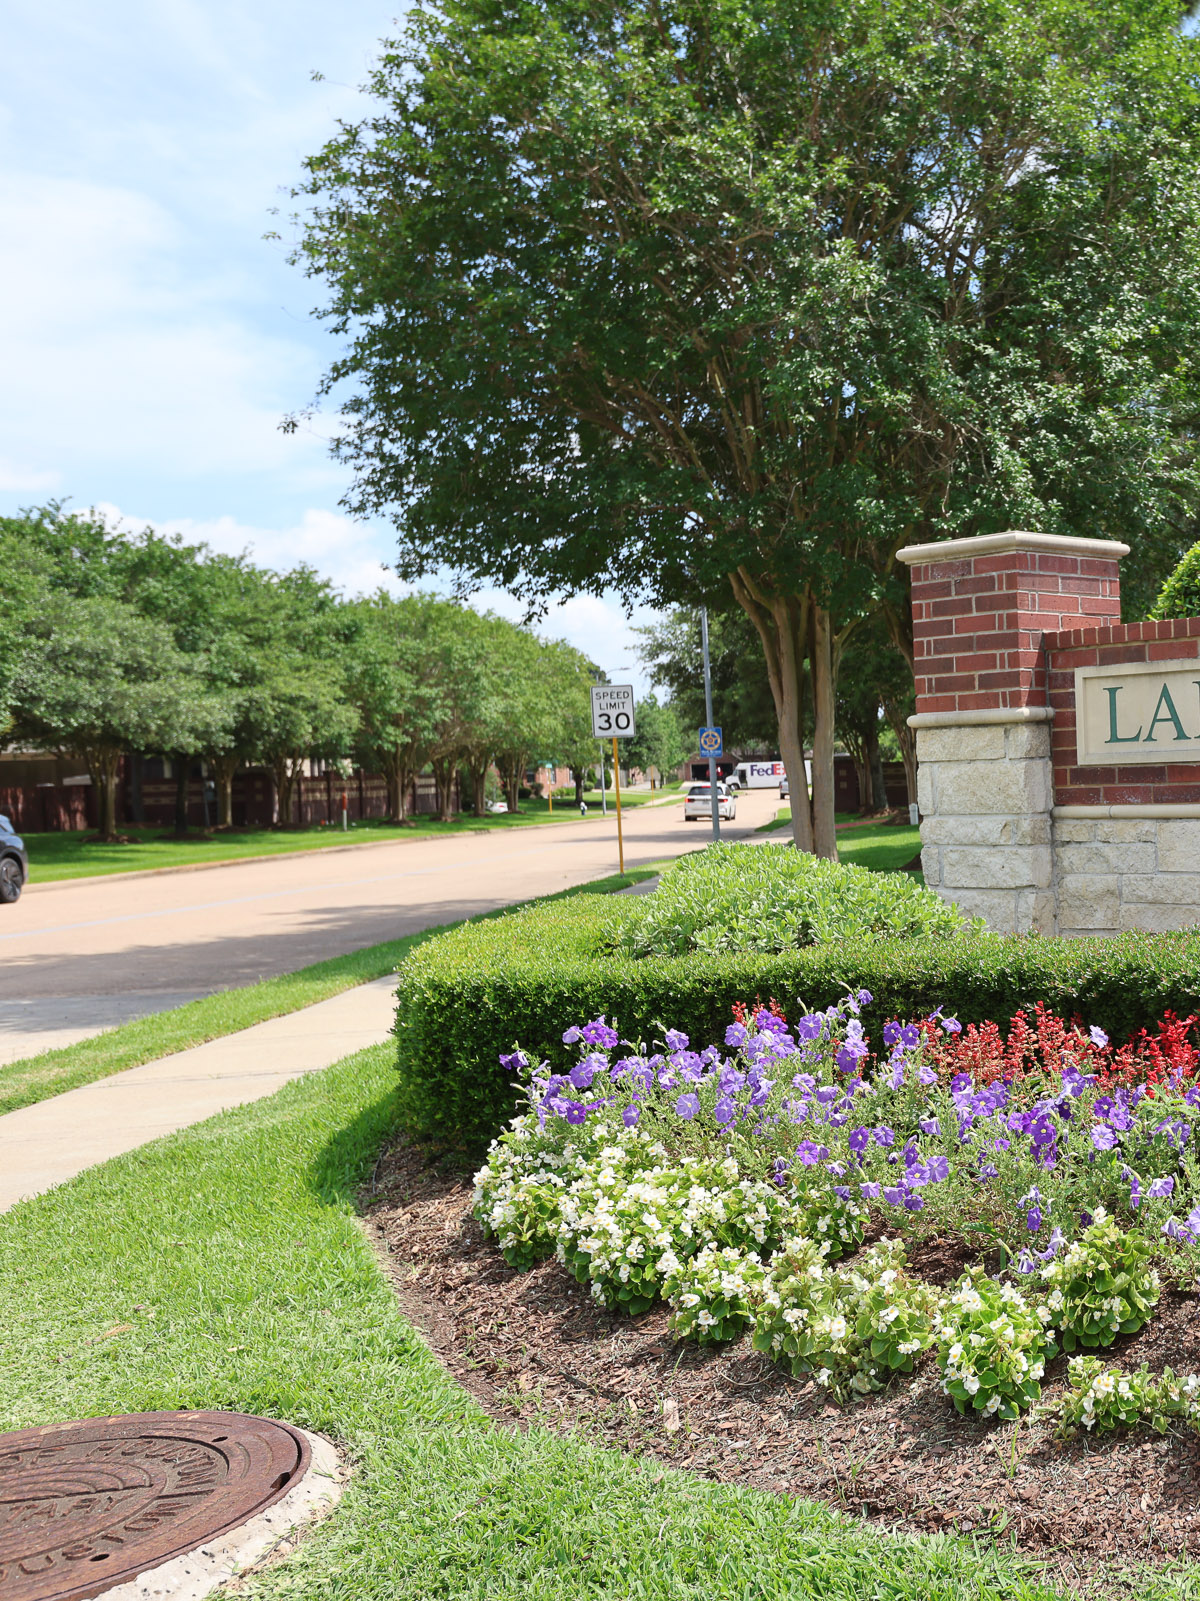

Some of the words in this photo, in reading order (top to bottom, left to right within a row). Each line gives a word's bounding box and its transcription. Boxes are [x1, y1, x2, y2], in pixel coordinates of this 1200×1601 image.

[595, 690, 630, 701] SPEED
[599, 701, 626, 711] LIMIT
[598, 712, 630, 731] 30
